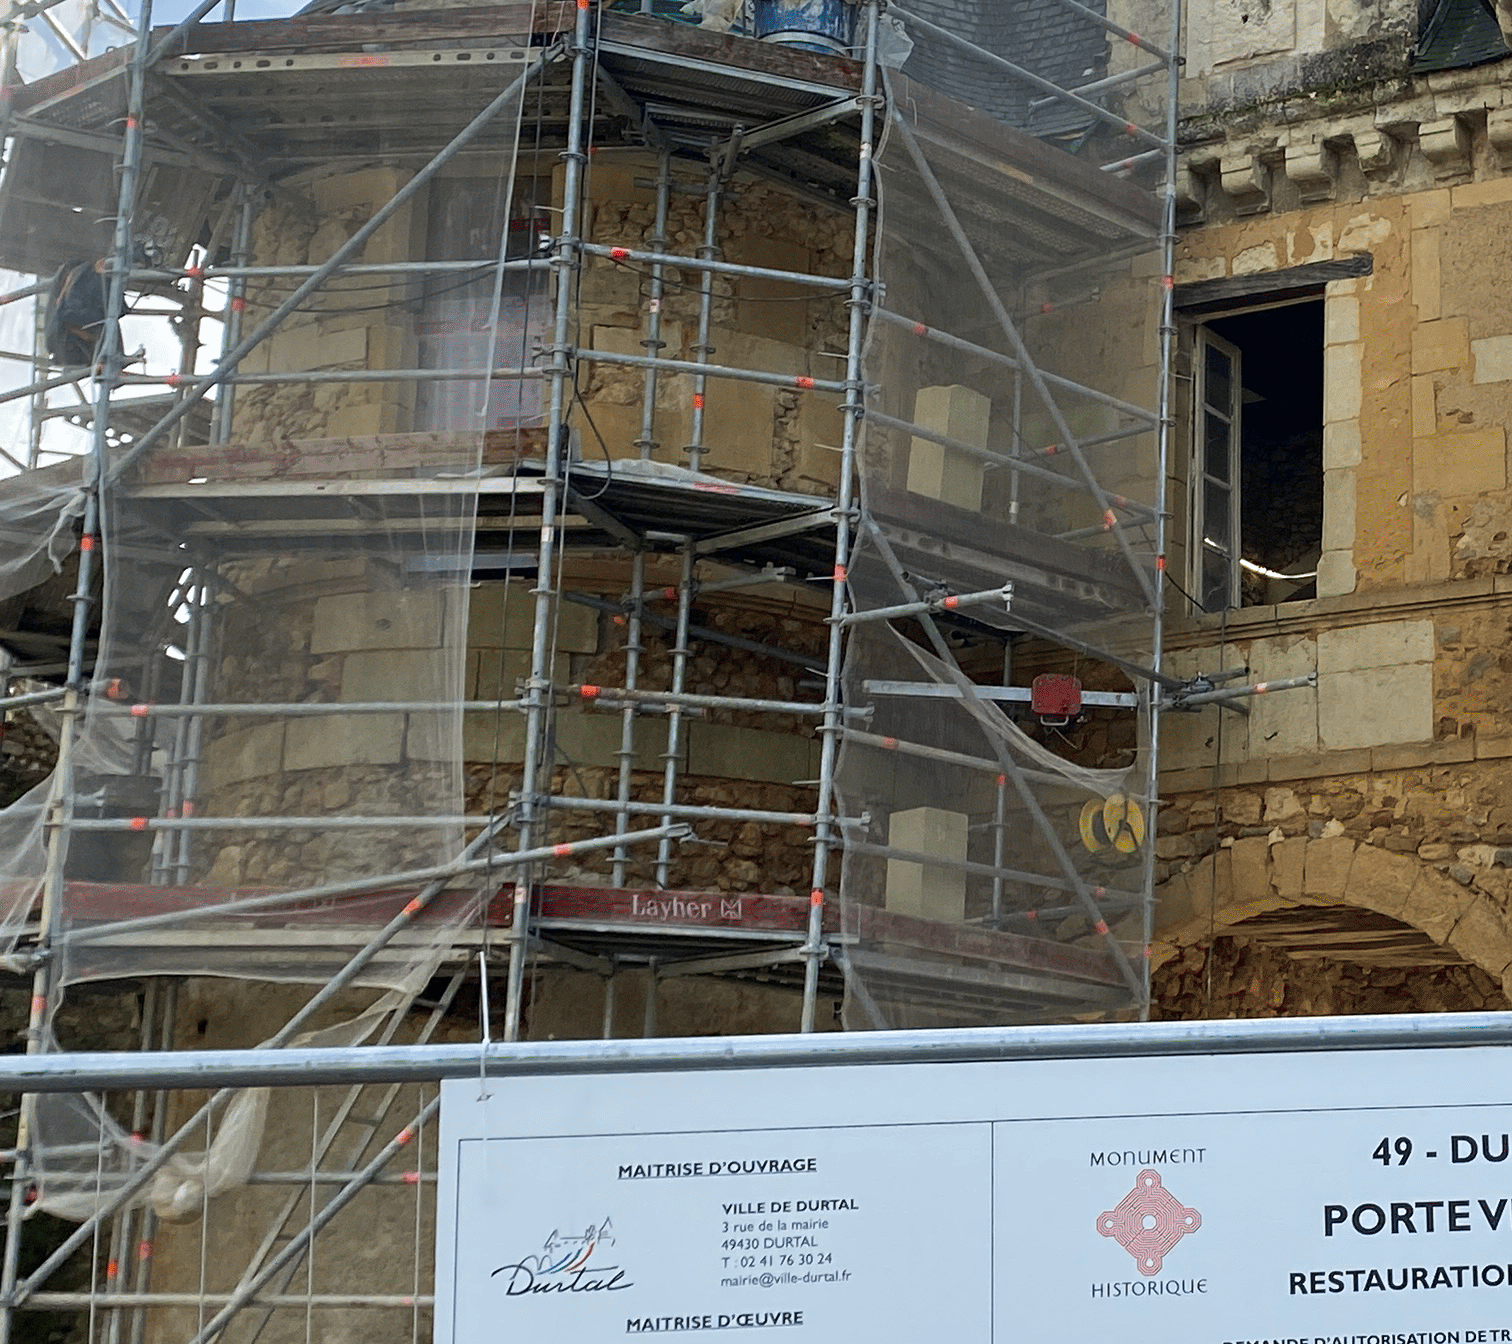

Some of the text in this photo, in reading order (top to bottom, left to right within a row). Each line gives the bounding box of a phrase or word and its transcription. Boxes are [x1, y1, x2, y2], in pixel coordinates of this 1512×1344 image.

[634, 894, 712, 921] Layher
[1090, 1147, 1207, 1167] MONUMENT
[1372, 1136, 1413, 1167] 49
[618, 1157, 817, 1179] MAITRISE D'OUVRAGE
[721, 1198, 860, 1215] VILLE DE DURTAL
[1323, 1199, 1472, 1237] PORTE
[720, 1235, 819, 1251] 49430 DURTAL
[491, 1263, 633, 1297] Durtal
[1091, 1278, 1208, 1299] HISTORIQUE
[626, 1310, 804, 1332] MAITRISE D'ŒUVRE
[1465, 1329, 1496, 1344] DE
